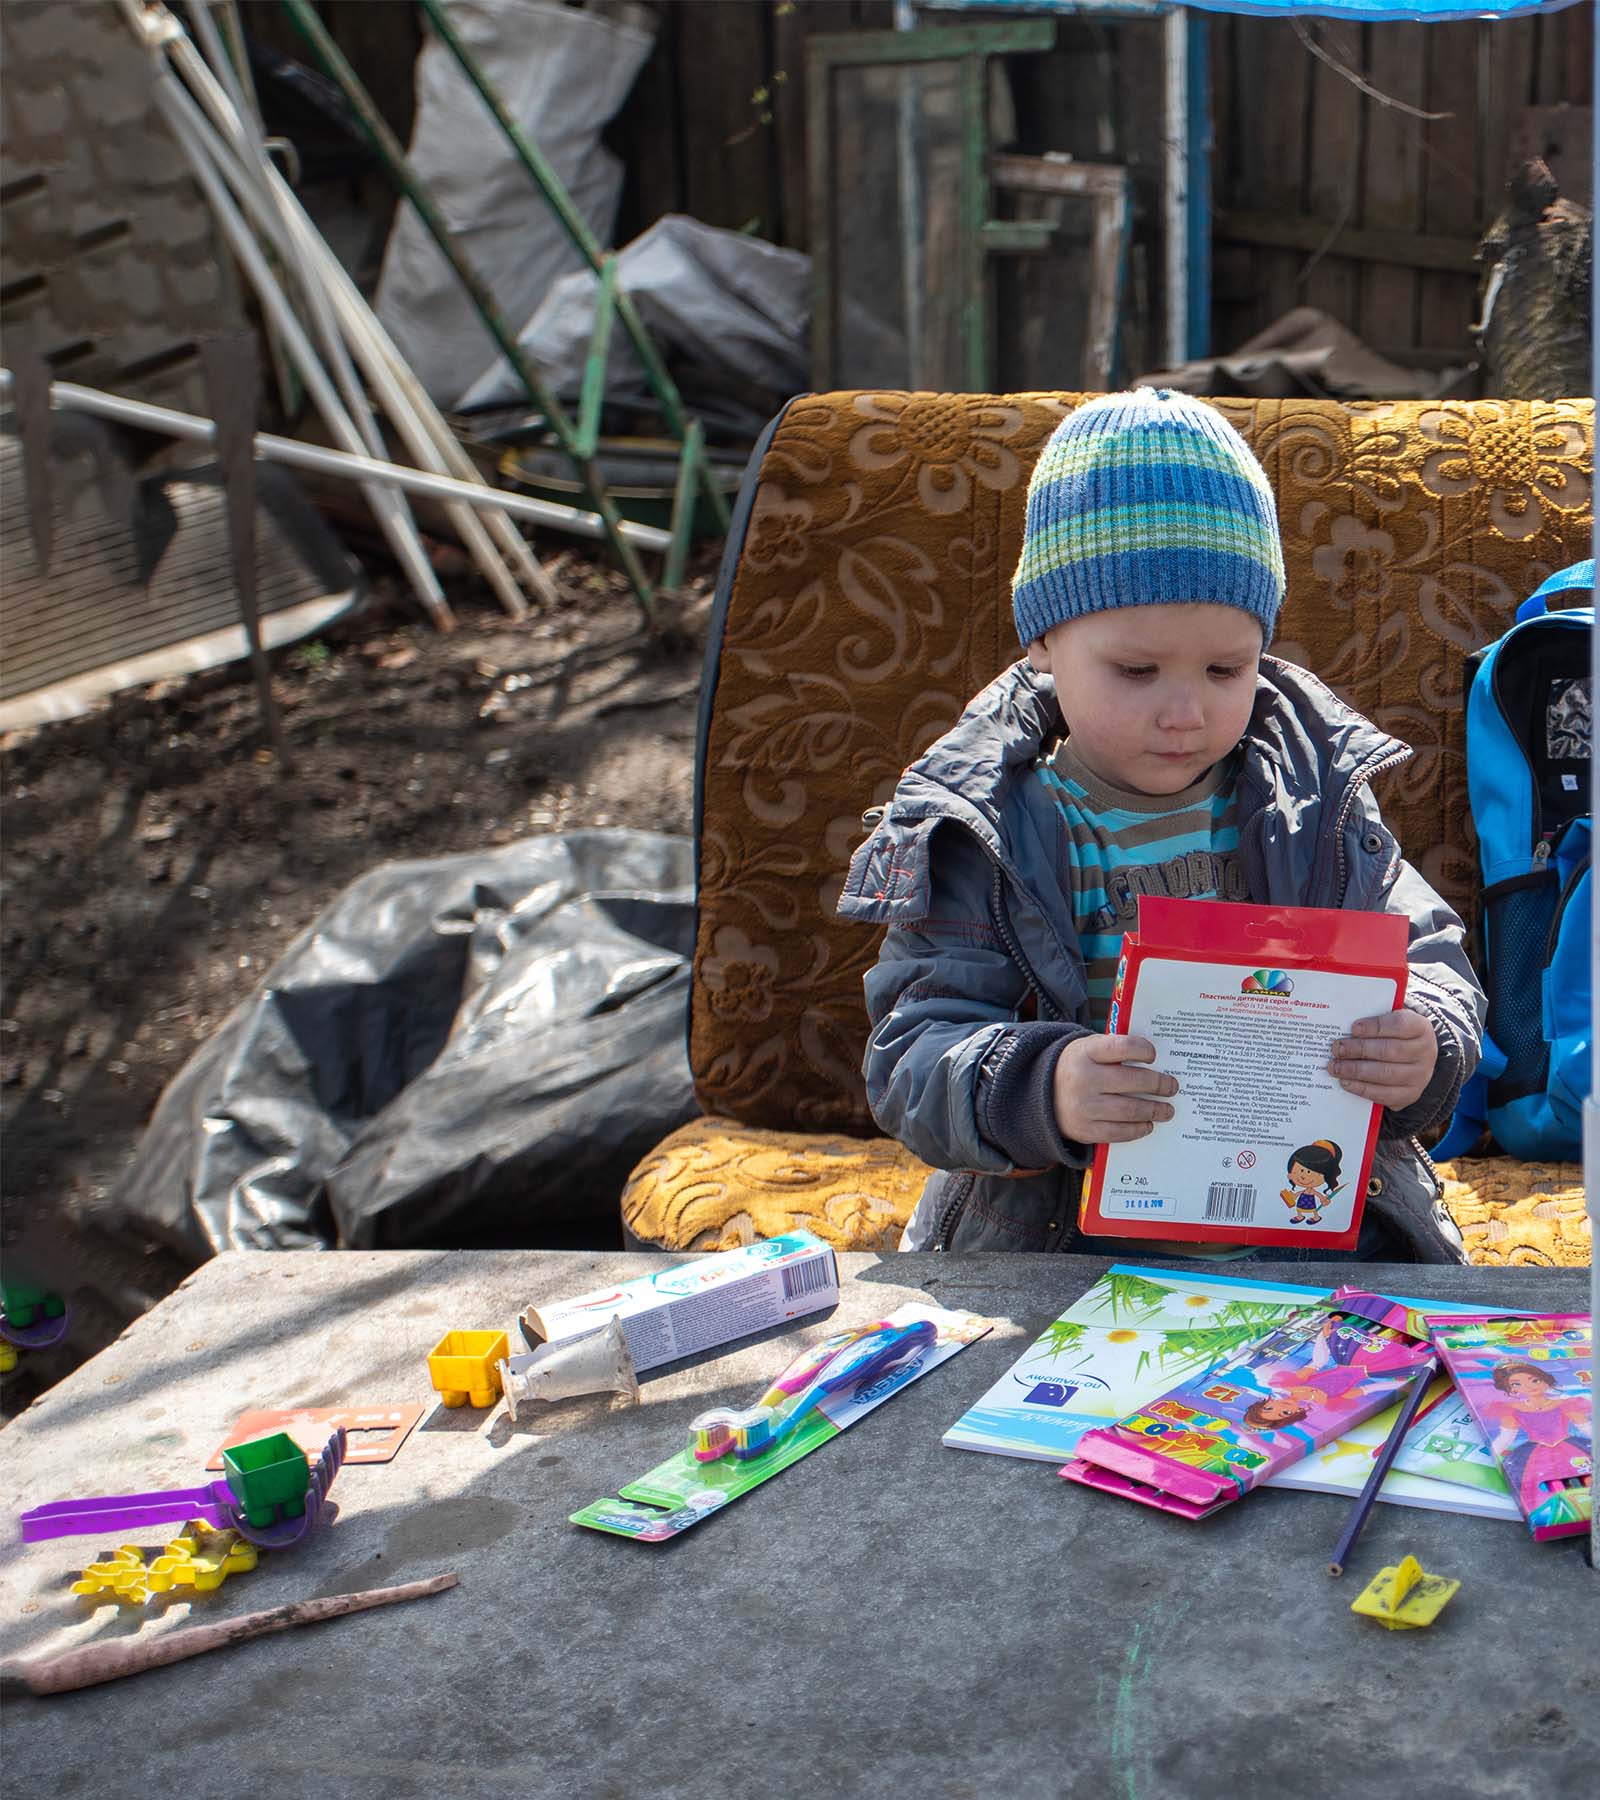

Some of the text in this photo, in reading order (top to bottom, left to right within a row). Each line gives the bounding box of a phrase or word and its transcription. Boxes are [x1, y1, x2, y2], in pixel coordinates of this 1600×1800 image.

[1444, 1330, 1592, 1350] КОЛЬОРО
[1026, 1374, 1102, 1389] ПО-НАШОМУ
[1203, 1385, 1241, 1403] 12
[1149, 1400, 1233, 1431] ОЛІВЦІ
[1120, 1413, 1269, 1470] КОЛЬОРОВІ
